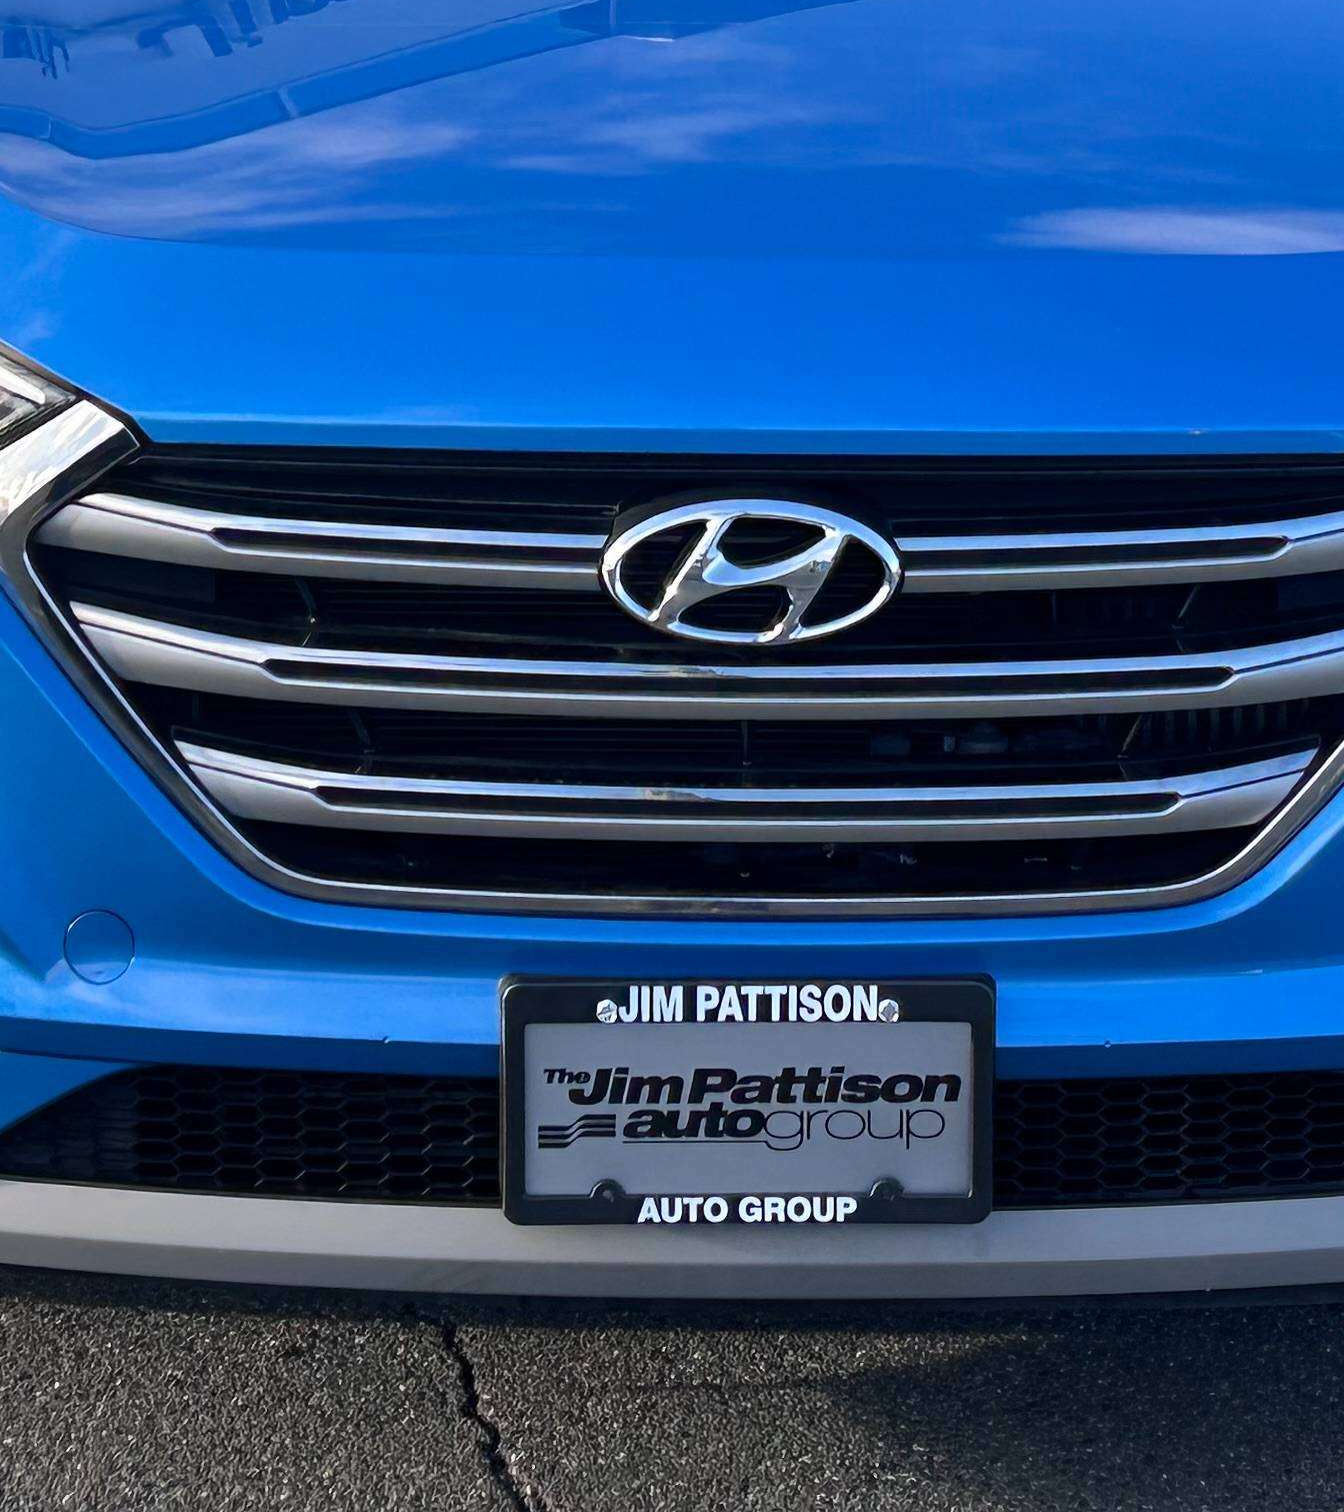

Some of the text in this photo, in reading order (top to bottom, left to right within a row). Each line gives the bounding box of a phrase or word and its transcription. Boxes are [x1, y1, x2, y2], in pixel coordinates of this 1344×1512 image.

[618, 984, 878, 1023] JIM PATTISON
[543, 1065, 961, 1106] The Jim Pattison
[637, 1196, 858, 1225] AUTO GROUP
